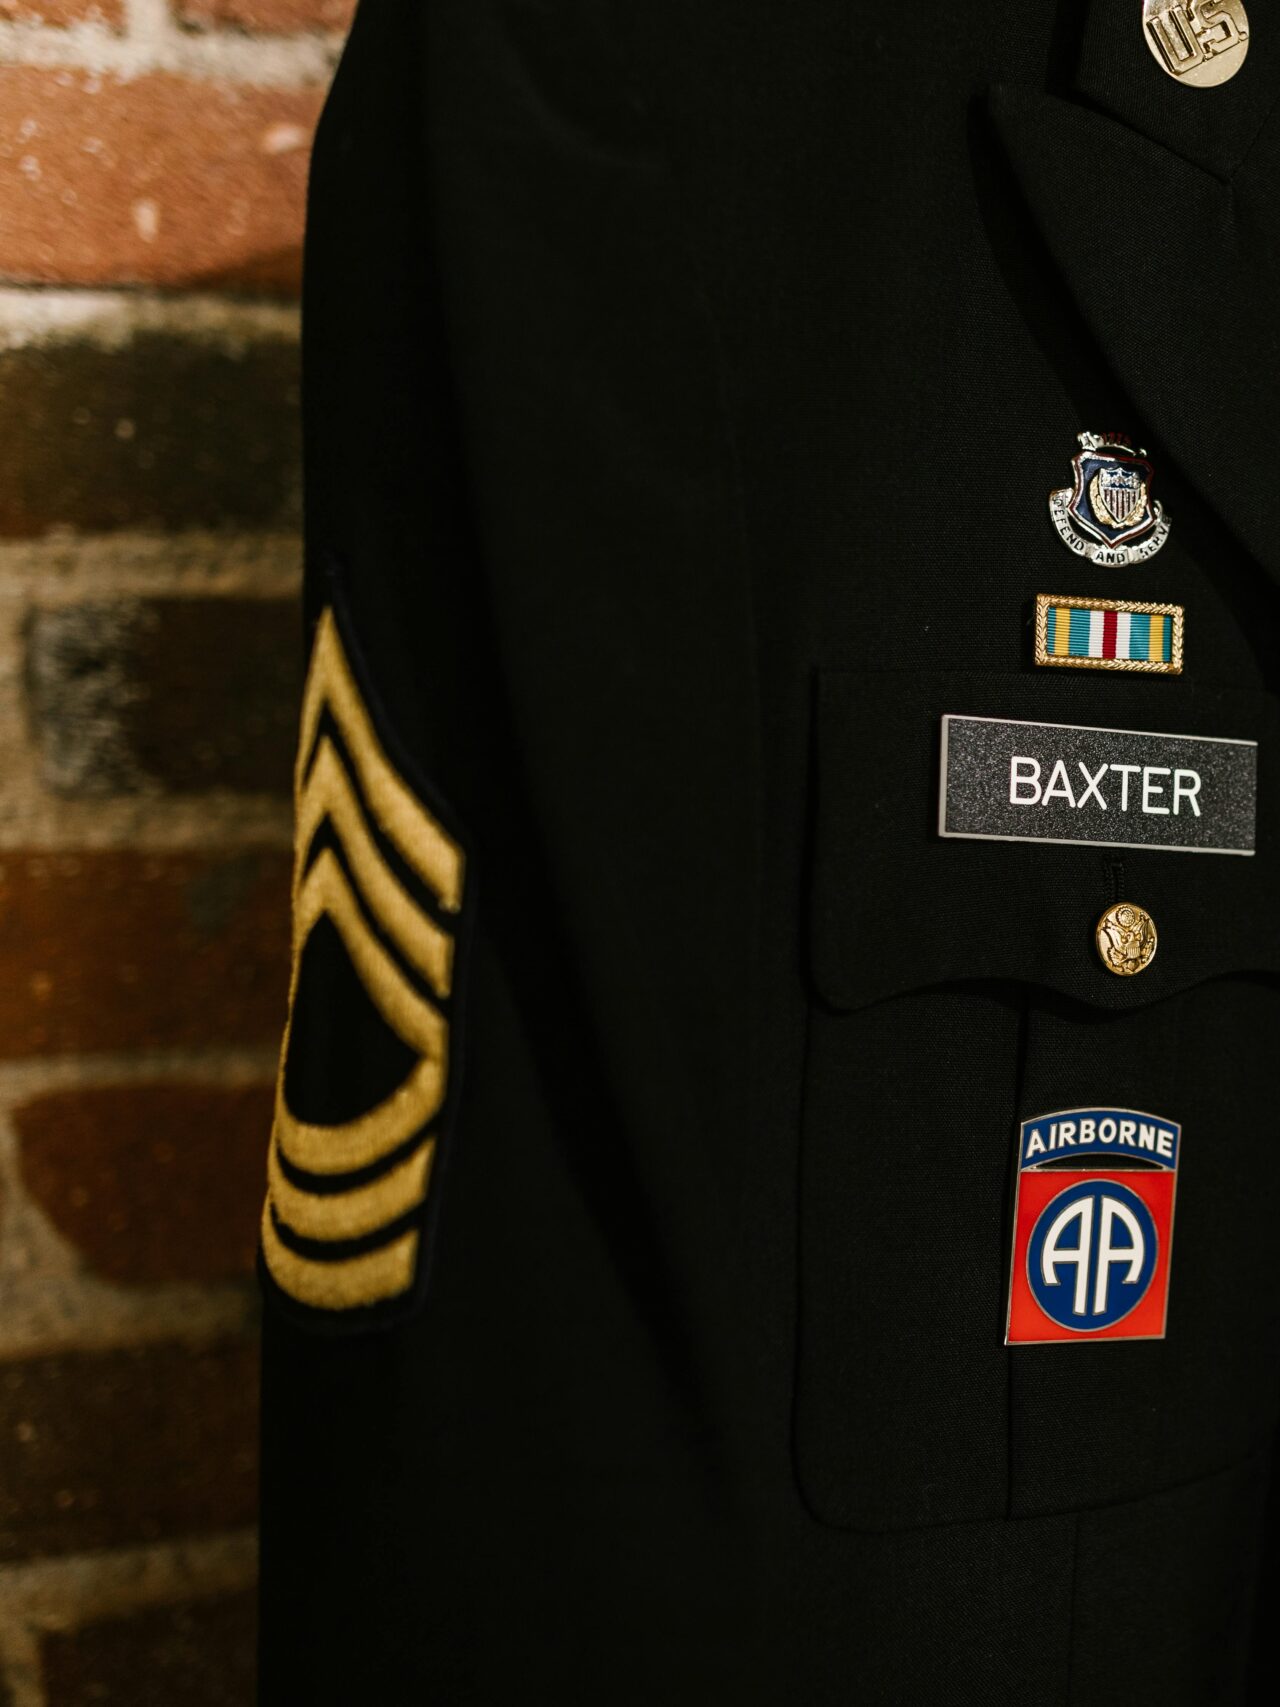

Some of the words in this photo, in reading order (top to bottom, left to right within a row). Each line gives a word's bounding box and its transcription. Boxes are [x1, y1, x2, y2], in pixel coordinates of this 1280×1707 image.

[1052, 493, 1085, 551] DEFEND
[1096, 551, 1125, 564] AND
[1009, 755, 1202, 817] BAXTER
[1025, 1118, 1174, 1159] AIRBORNE
[1042, 1196, 1145, 1315] AA
